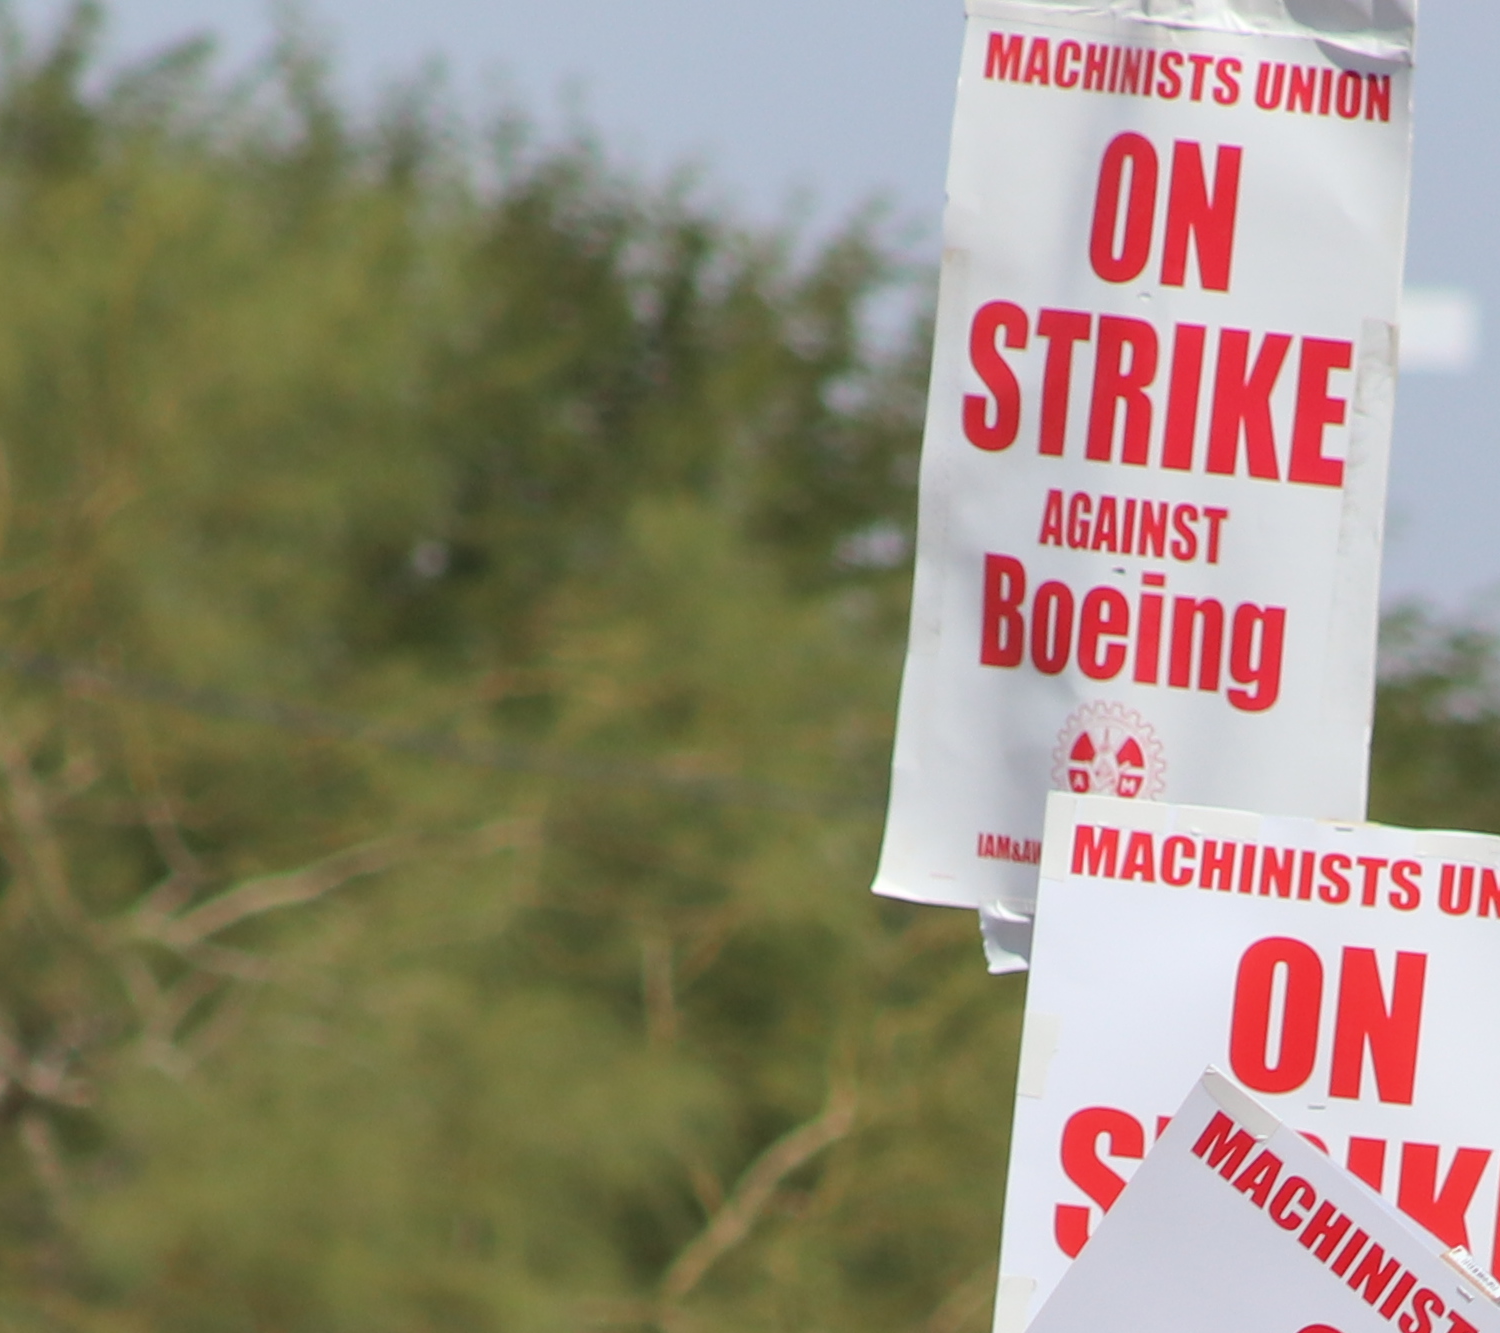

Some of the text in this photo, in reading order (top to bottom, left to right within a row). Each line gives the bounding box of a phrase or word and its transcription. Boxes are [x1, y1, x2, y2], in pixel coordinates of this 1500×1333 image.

[985, 34, 1391, 121] MACHINISTS UNION
[1090, 133, 1243, 292] ON
[963, 302, 1354, 487] STRIKE
[1040, 490, 1229, 564] AGAINST
[981, 554, 1287, 712] Boeing
[1072, 825, 1423, 911] MACHINISTS
[1229, 936, 1428, 1105] ON
